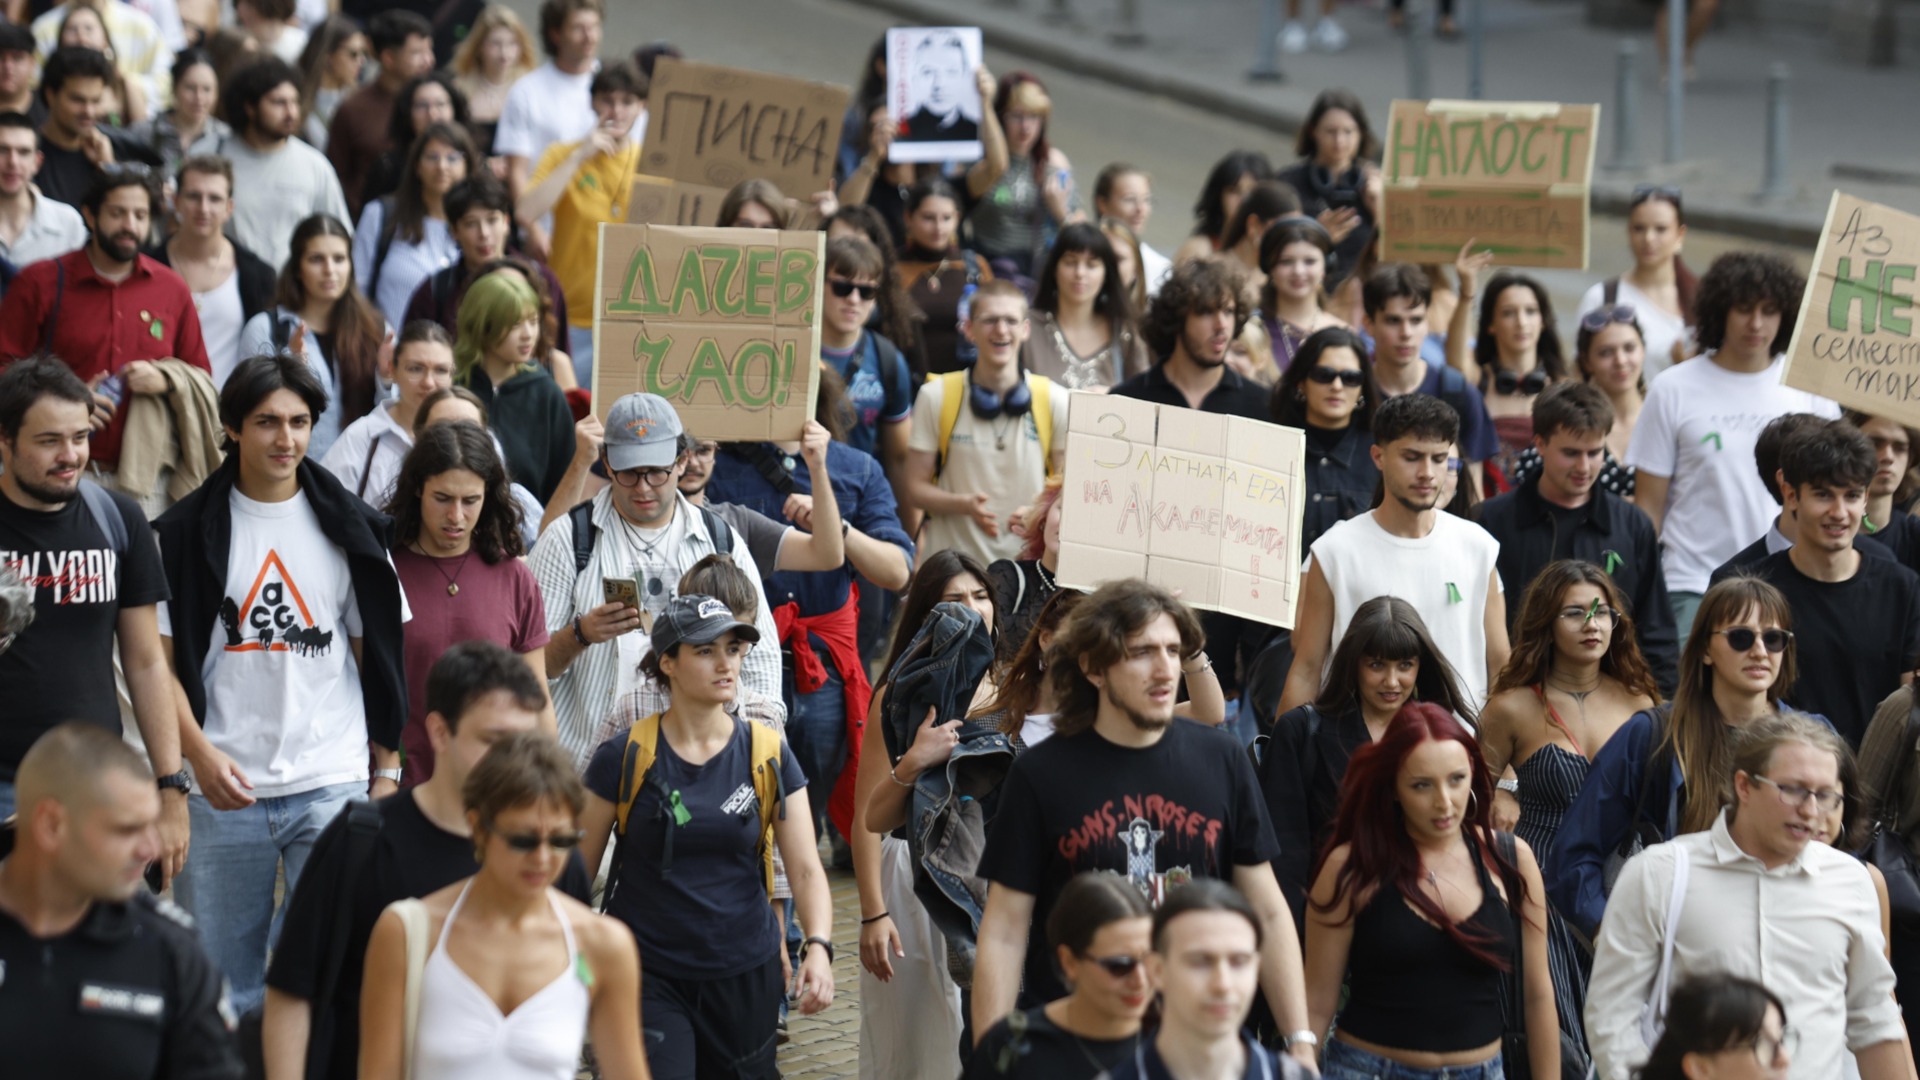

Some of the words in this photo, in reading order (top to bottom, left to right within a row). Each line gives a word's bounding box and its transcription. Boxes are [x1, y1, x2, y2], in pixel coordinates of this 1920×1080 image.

[660, 91, 829, 175] ПИСНА
[1393, 118, 1586, 184] НАГЛОСТ
[1465, 205, 1563, 232] МОРЕТА
[1827, 255, 1917, 337] НЕ
[633, 330, 797, 411] ЧАО!
[1083, 479, 1114, 504] НА
[1246, 473, 1287, 508] ЕРА
[46, 548, 117, 604] YORK
[1145, 794, 1222, 848] ROSES
